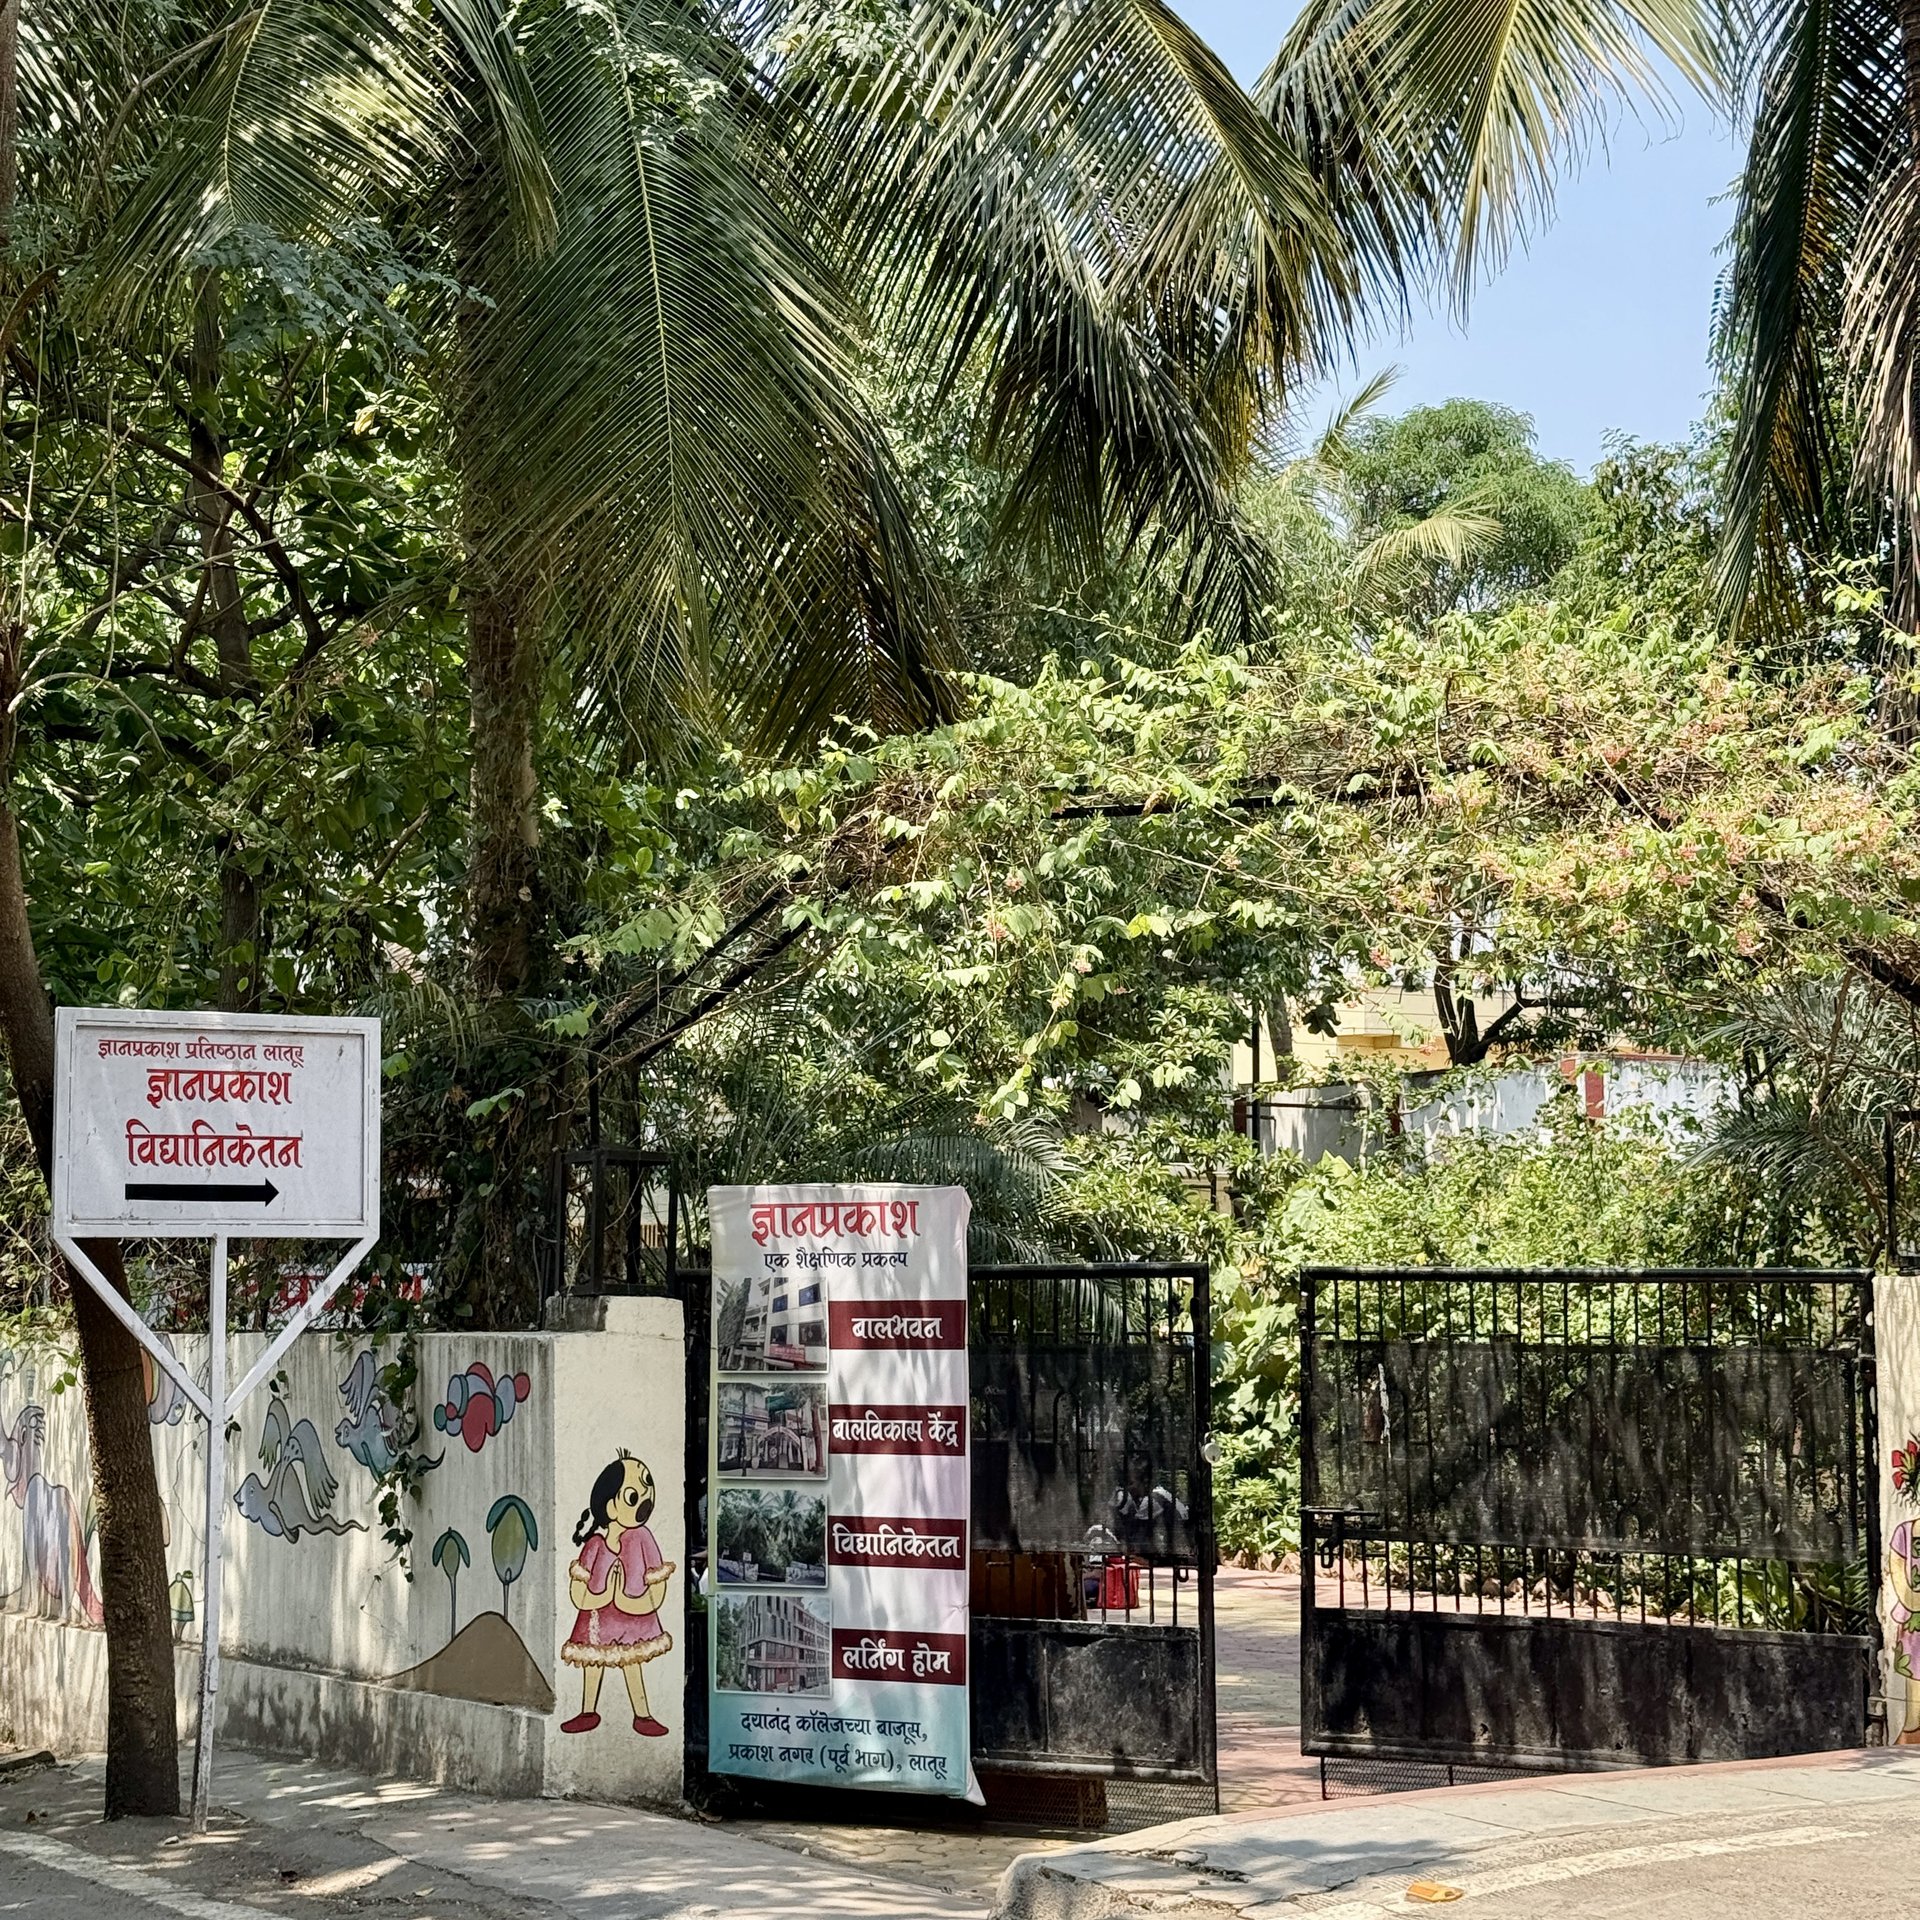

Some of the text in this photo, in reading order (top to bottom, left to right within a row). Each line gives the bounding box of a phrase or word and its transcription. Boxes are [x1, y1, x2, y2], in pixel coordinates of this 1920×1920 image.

[98, 1036, 305, 1069] ज्ञानप्रकाश प्रतिष्ठान लातूर
[146, 1068, 293, 1109] ज्ञानप्रकाश
[125, 1118, 304, 1169] विद्यानिकेतन
[750, 1200, 920, 1247] ज्ञानप्रकाश
[763, 1246, 909, 1273] एक शैक्षणिक प्रकल्प
[851, 1314, 944, 1340] बालभवन
[831, 1409, 959, 1448] बालविकास केंद्र
[831, 1523, 961, 1559] विद्यानिकेतन
[841, 1637, 951, 1678] लर्निंग होम
[741, 1707, 928, 1746] दयानंद कॉलेजच्या बाजूस,
[728, 1743, 948, 1781] प्रकाश नगर (पूर्व भाग), लातूर
